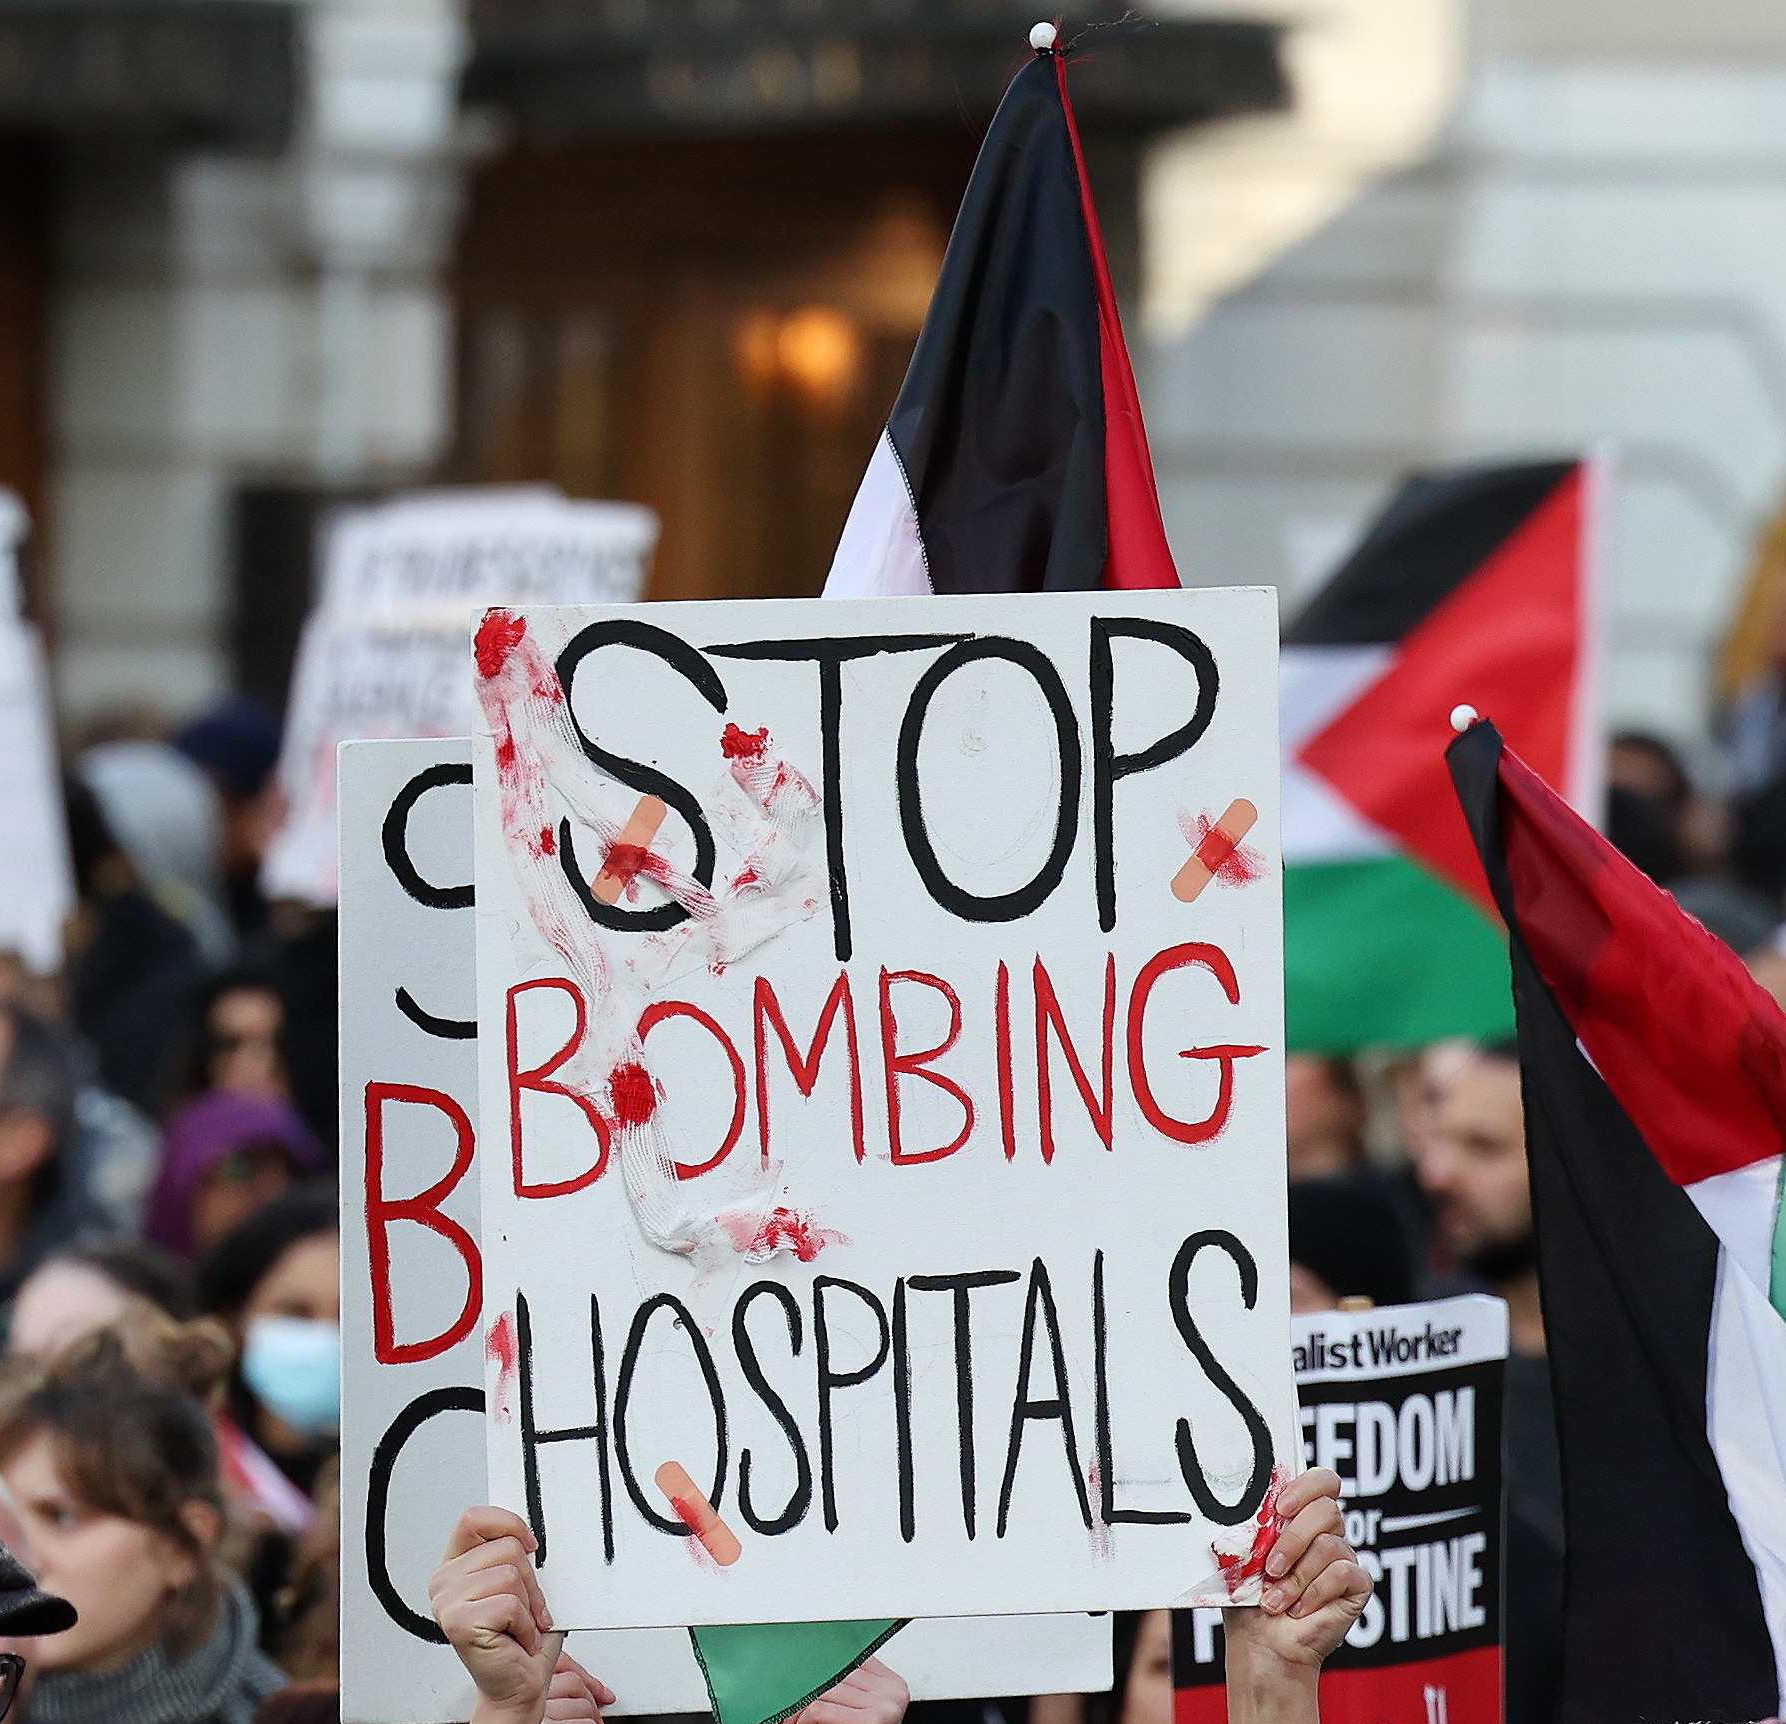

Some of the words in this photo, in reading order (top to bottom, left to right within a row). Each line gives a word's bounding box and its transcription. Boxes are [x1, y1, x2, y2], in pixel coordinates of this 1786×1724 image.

[557, 617, 1218, 961] STOP
[507, 941, 1270, 1199] BOMBING
[518, 1230, 1276, 1567] HOSPITALS
[1367, 1323, 1462, 1367] Worker
[1340, 1500, 1383, 1547] or
